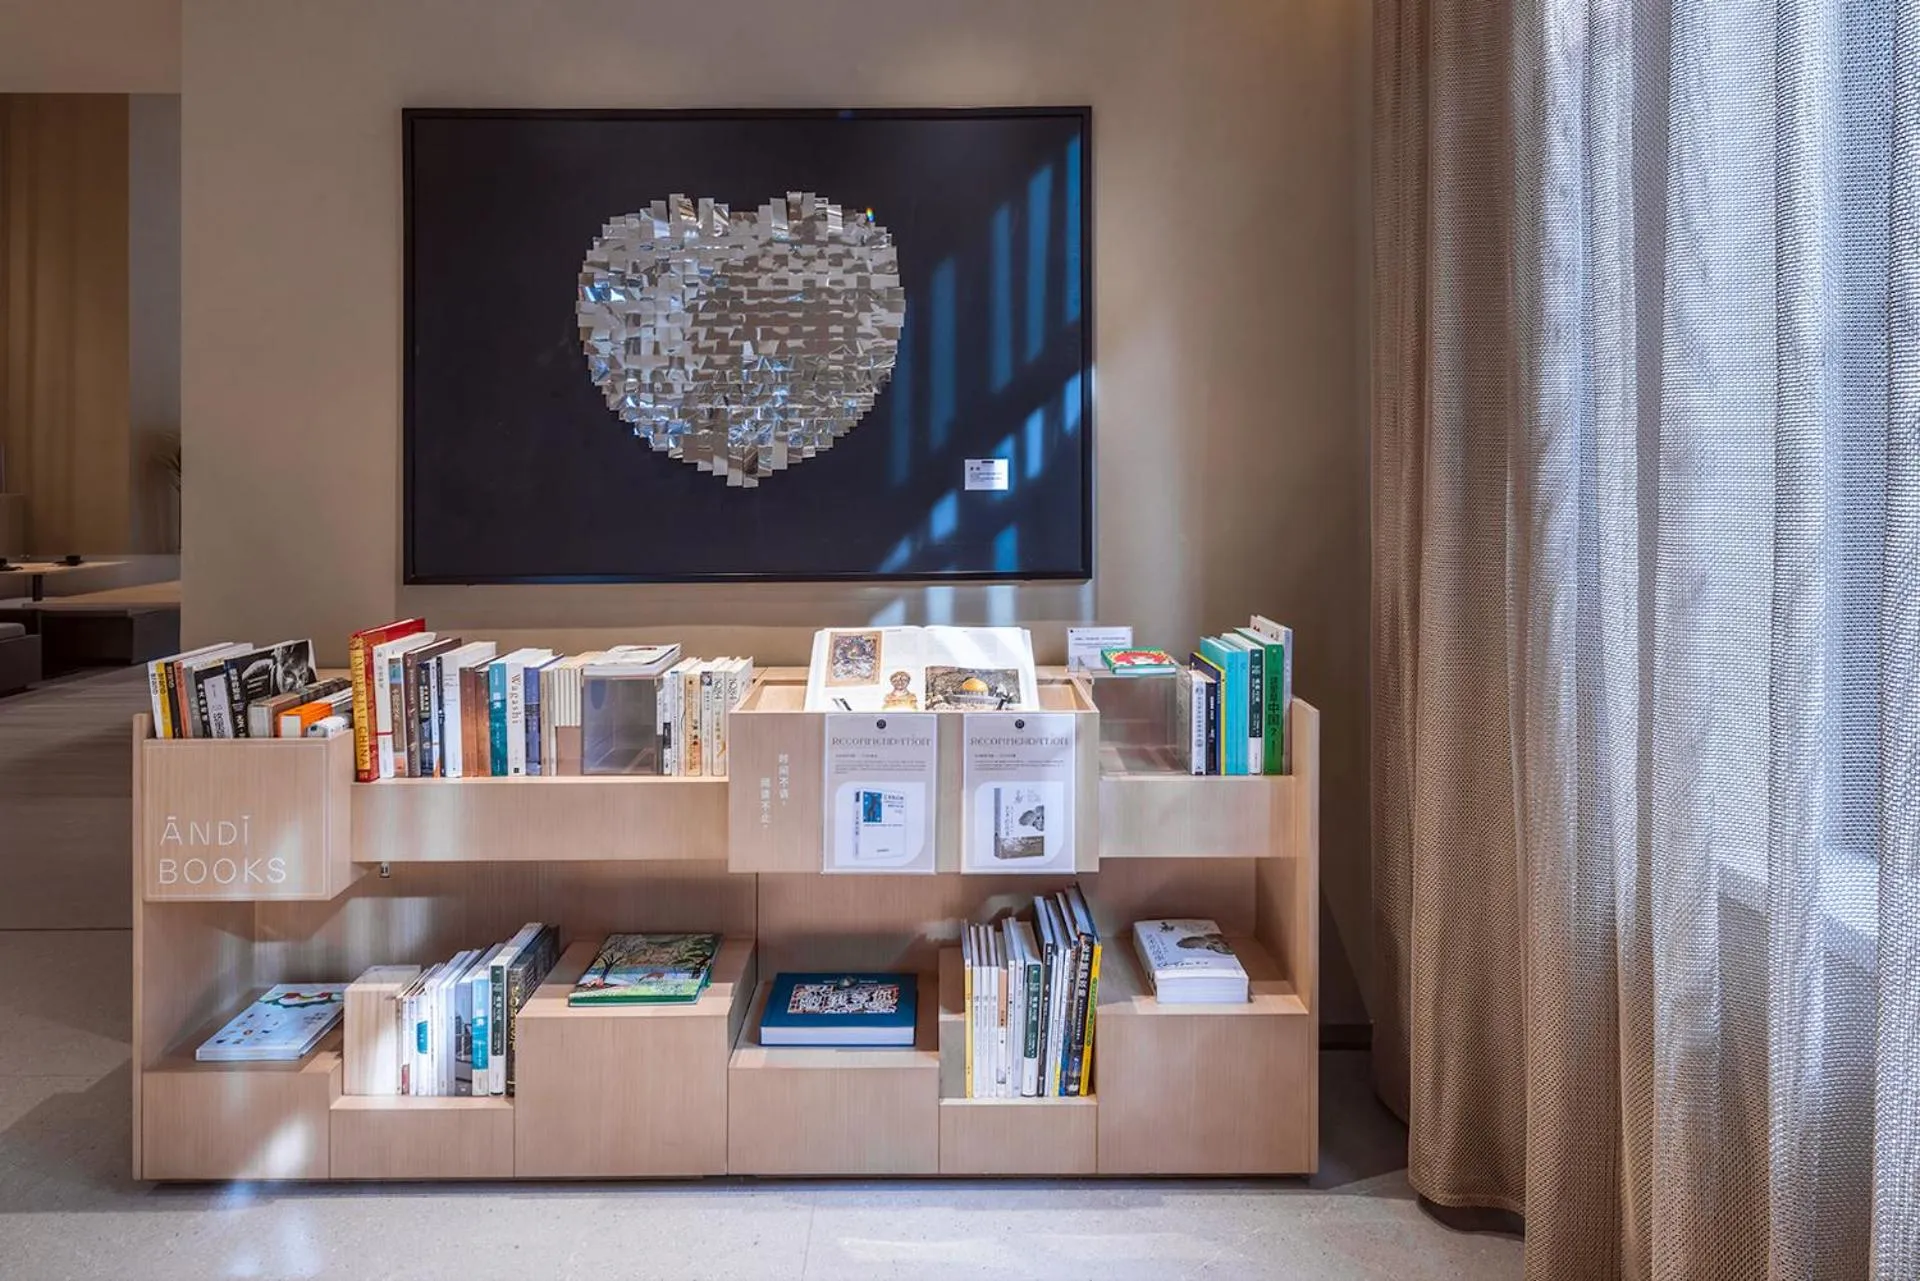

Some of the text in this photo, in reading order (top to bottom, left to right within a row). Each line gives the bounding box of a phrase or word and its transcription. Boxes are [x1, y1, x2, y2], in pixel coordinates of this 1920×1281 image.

[353, 655, 369, 767] IMPERIAL CHINA
[509, 673, 522, 725] Wagashi
[158, 857, 287, 885] BOOKS
